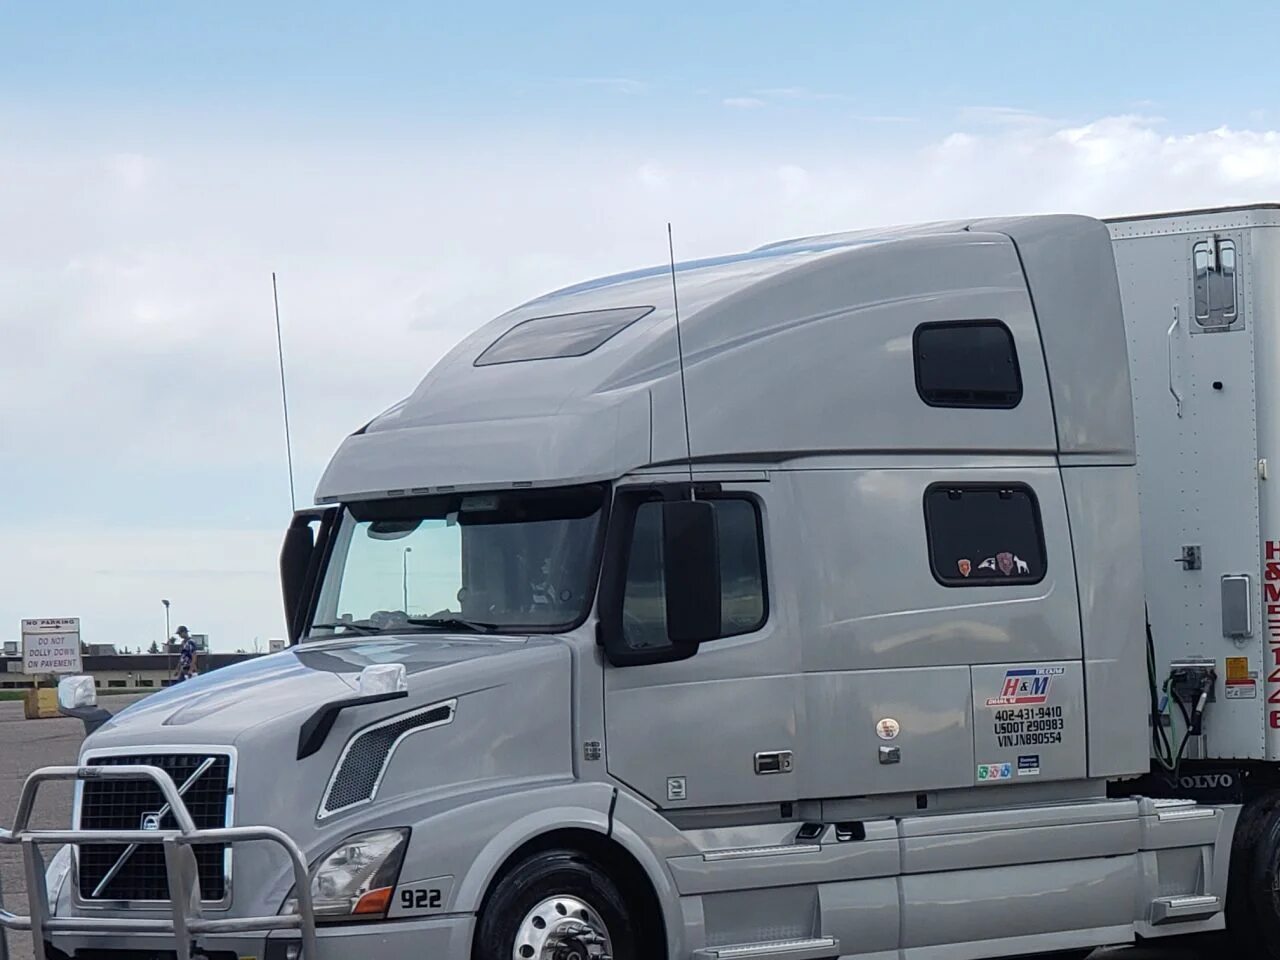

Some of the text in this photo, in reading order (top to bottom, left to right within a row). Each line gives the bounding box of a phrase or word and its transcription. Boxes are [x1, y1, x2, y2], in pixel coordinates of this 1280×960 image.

[38, 637, 65, 645] DO NOT
[29, 648, 75, 657] DOLLY DOWN
[27, 659, 77, 668] ON PAVEMENT
[995, 706, 1062, 722] 402-431-9410
[994, 718, 1064, 735] USDOT 290983
[401, 888, 442, 909] 922
